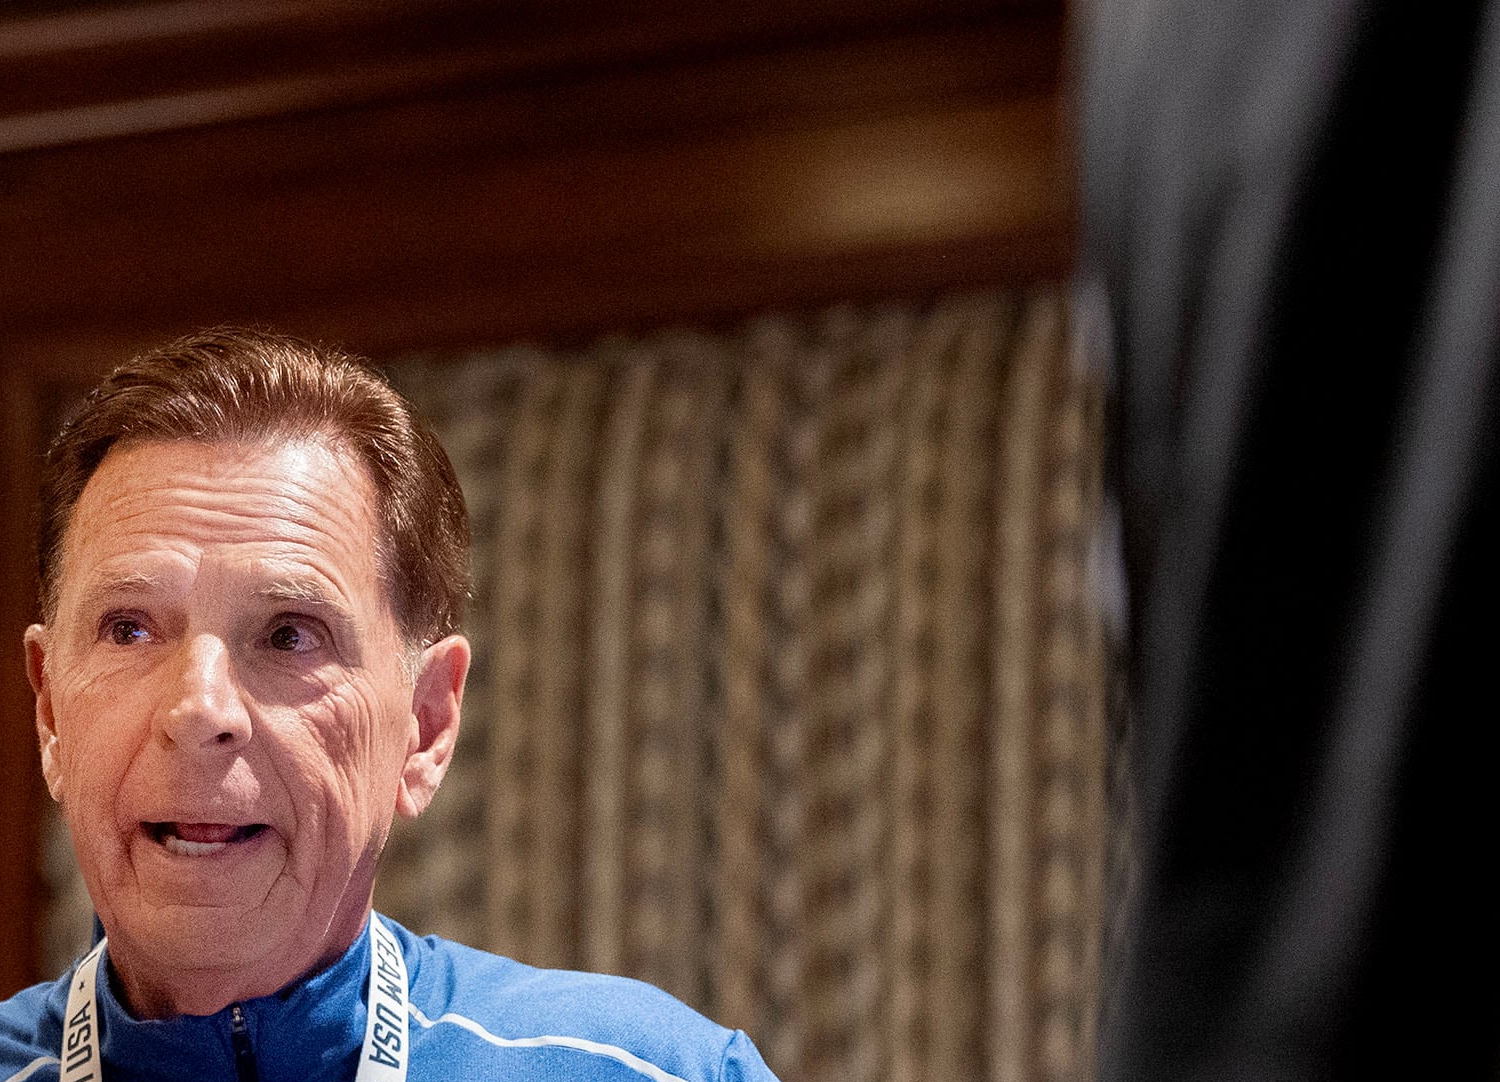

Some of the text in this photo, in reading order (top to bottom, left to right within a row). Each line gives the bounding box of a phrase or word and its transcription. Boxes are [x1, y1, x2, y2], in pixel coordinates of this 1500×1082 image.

[66, 1000, 95, 1073] USA
[369, 928, 403, 1070] TEAM USA
